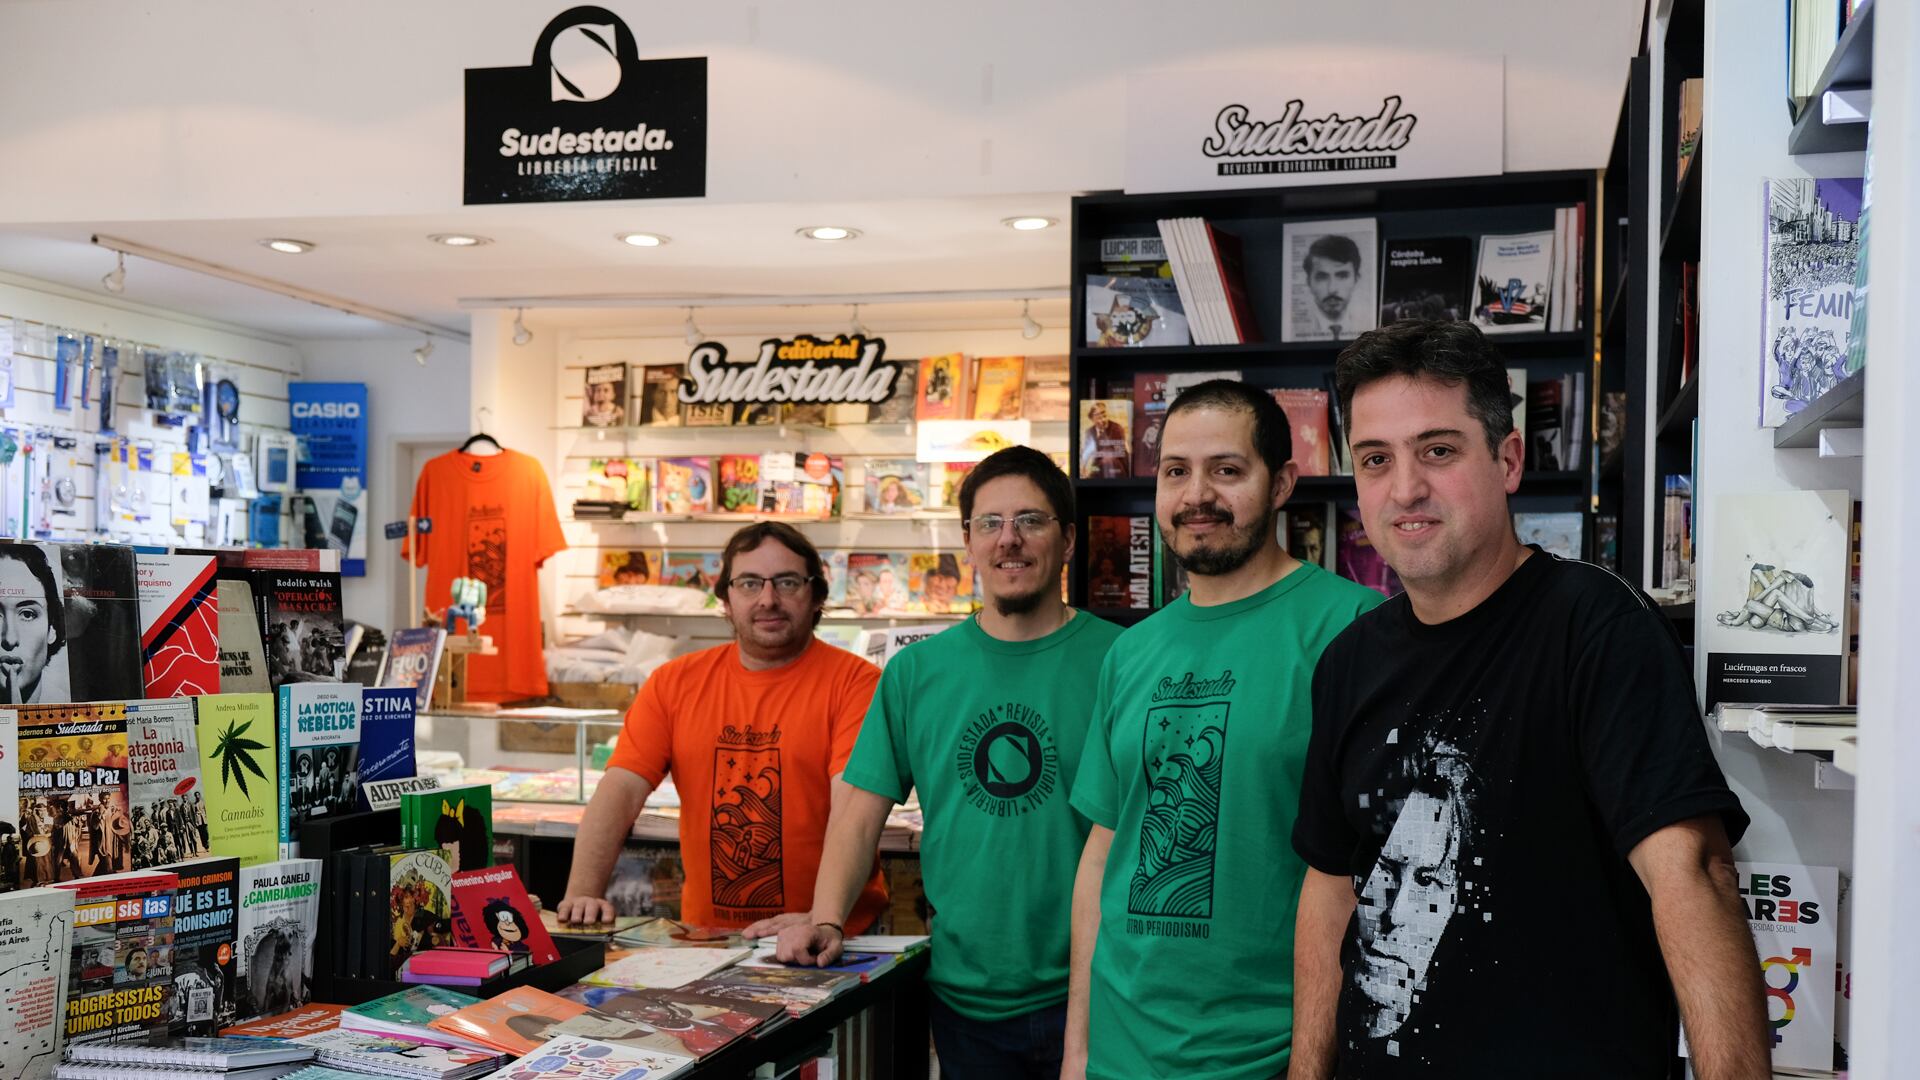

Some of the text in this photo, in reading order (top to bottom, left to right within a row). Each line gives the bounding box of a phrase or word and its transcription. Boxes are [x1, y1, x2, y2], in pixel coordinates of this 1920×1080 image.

[1202, 95, 1418, 157] Sudestada
[499, 123, 674, 157] Sudestada.
[595, 156, 658, 174] OFICIAL
[1223, 162, 1264, 174] REVISTA
[1278, 158, 1330, 172] EDITORIAL
[1103, 240, 1138, 255] LUCHA
[1391, 249, 1424, 259] Córdoba
[1390, 256, 1443, 267] respira lucha
[777, 337, 859, 360] editorial
[678, 343, 898, 403] Sudestada
[292, 402, 361, 418] CASIO
[1129, 517, 1150, 609] MALATESTA
[276, 578, 332, 588] Rodolfo Walsh
[221, 664, 253, 676] JÓVENES
[1723, 662, 1807, 676] Luciérnagas en frascos
[1151, 669, 1237, 702] Sudestada
[1722, 677, 1750, 685] MERCEDES
[215, 703, 237, 712] Andrea
[299, 701, 356, 715] LA NOTICIA
[153, 715, 175, 723] Borrero
[297, 713, 356, 733] REBELDE
[384, 713, 412, 721] KIRCHNER
[1006, 702, 1050, 740] REVISTA
[44, 727, 53, 736] de
[55, 719, 103, 736] Sudestada
[104, 724, 117, 732] #10
[142, 725, 158, 740] La
[128, 737, 185, 759] atagonia
[956, 707, 999, 780] SUDESTADA
[23, 758, 87, 769] indios invisibles del
[130, 755, 177, 776] trágica
[57, 769, 75, 787] de
[79, 769, 93, 787] la
[96, 767, 120, 786] Paz
[220, 805, 265, 823] Cannabis
[202, 871, 233, 884] GRIMSON
[253, 872, 311, 889] PAULA CANELO
[484, 869, 513, 884] singular
[175, 888, 193, 914] UÉ
[199, 890, 214, 910] ES
[217, 887, 233, 907] EL
[242, 882, 319, 909] ¿CAMBIAMOS?
[118, 898, 141, 918] sis
[144, 897, 168, 915] tas
[174, 908, 234, 935] RONISMO?
[1126, 917, 1211, 940] OTRO PERIODISMO
[1775, 923, 1799, 934] SEXUAL
[8, 936, 30, 945] Aires
[116, 1002, 161, 1025] TODOS
